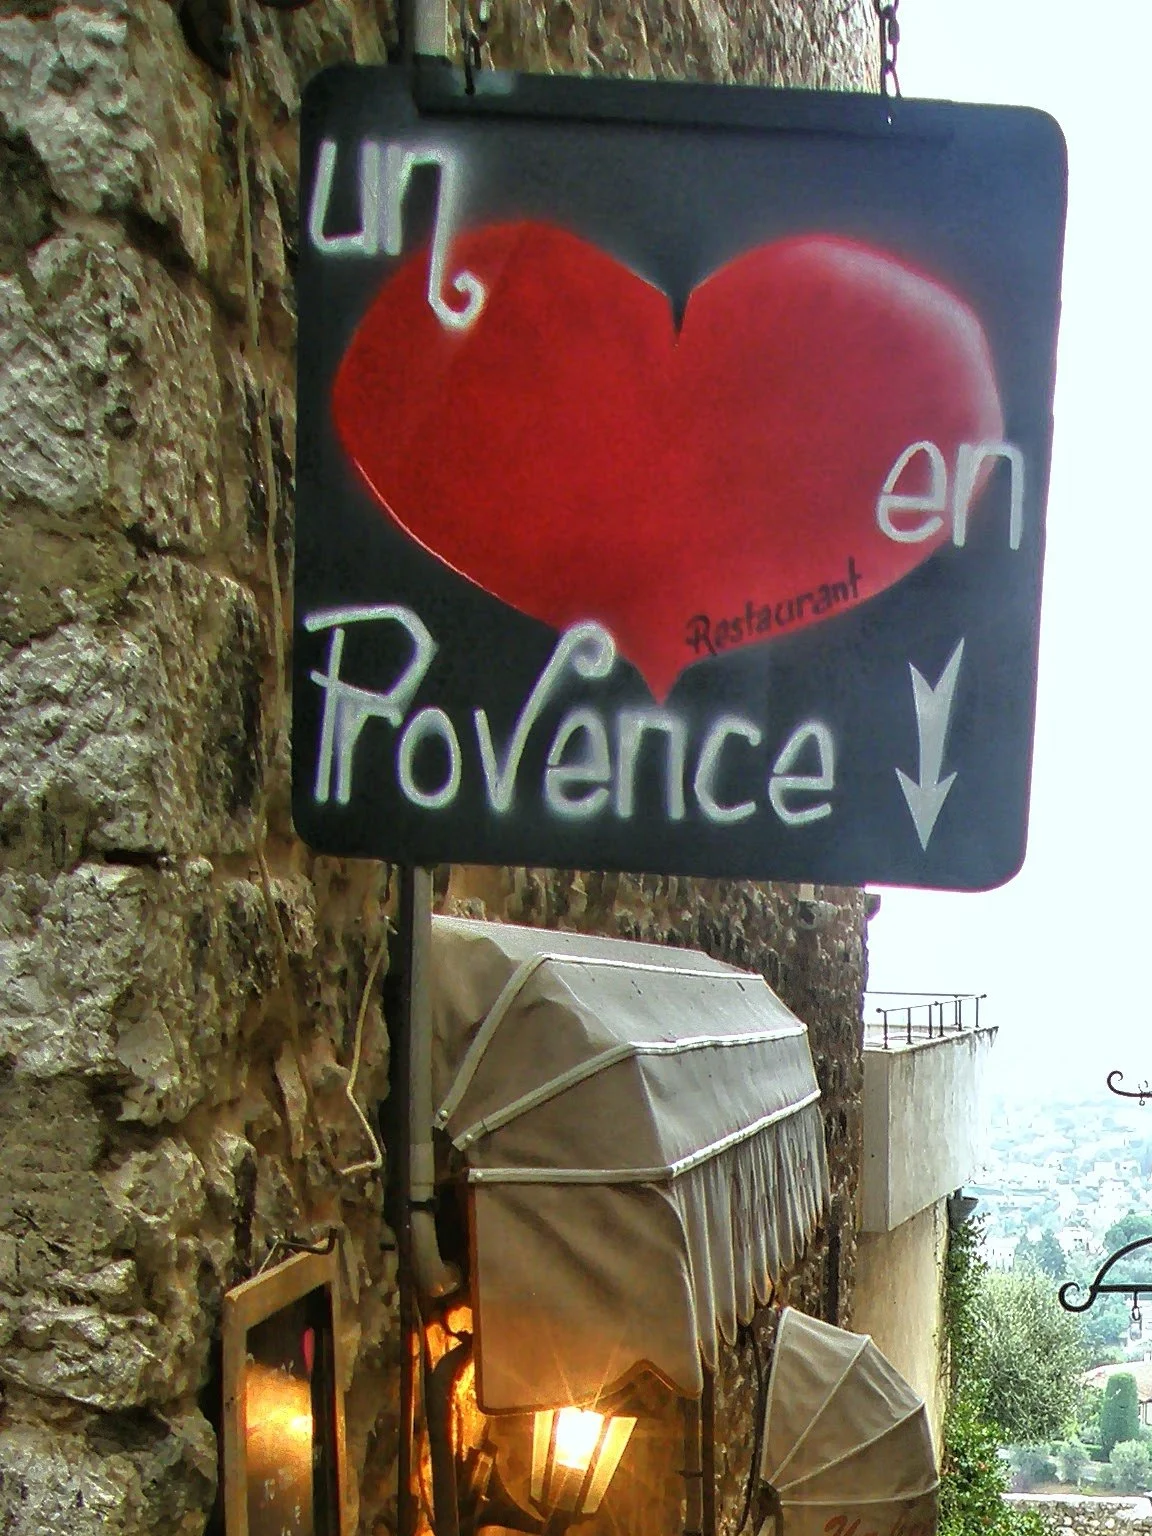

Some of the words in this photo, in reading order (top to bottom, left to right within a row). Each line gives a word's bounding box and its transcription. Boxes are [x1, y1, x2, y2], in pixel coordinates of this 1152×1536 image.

[876, 441, 1025, 550] en
[686, 556, 862, 656] Restaurant
[304, 605, 836, 825] Provence
